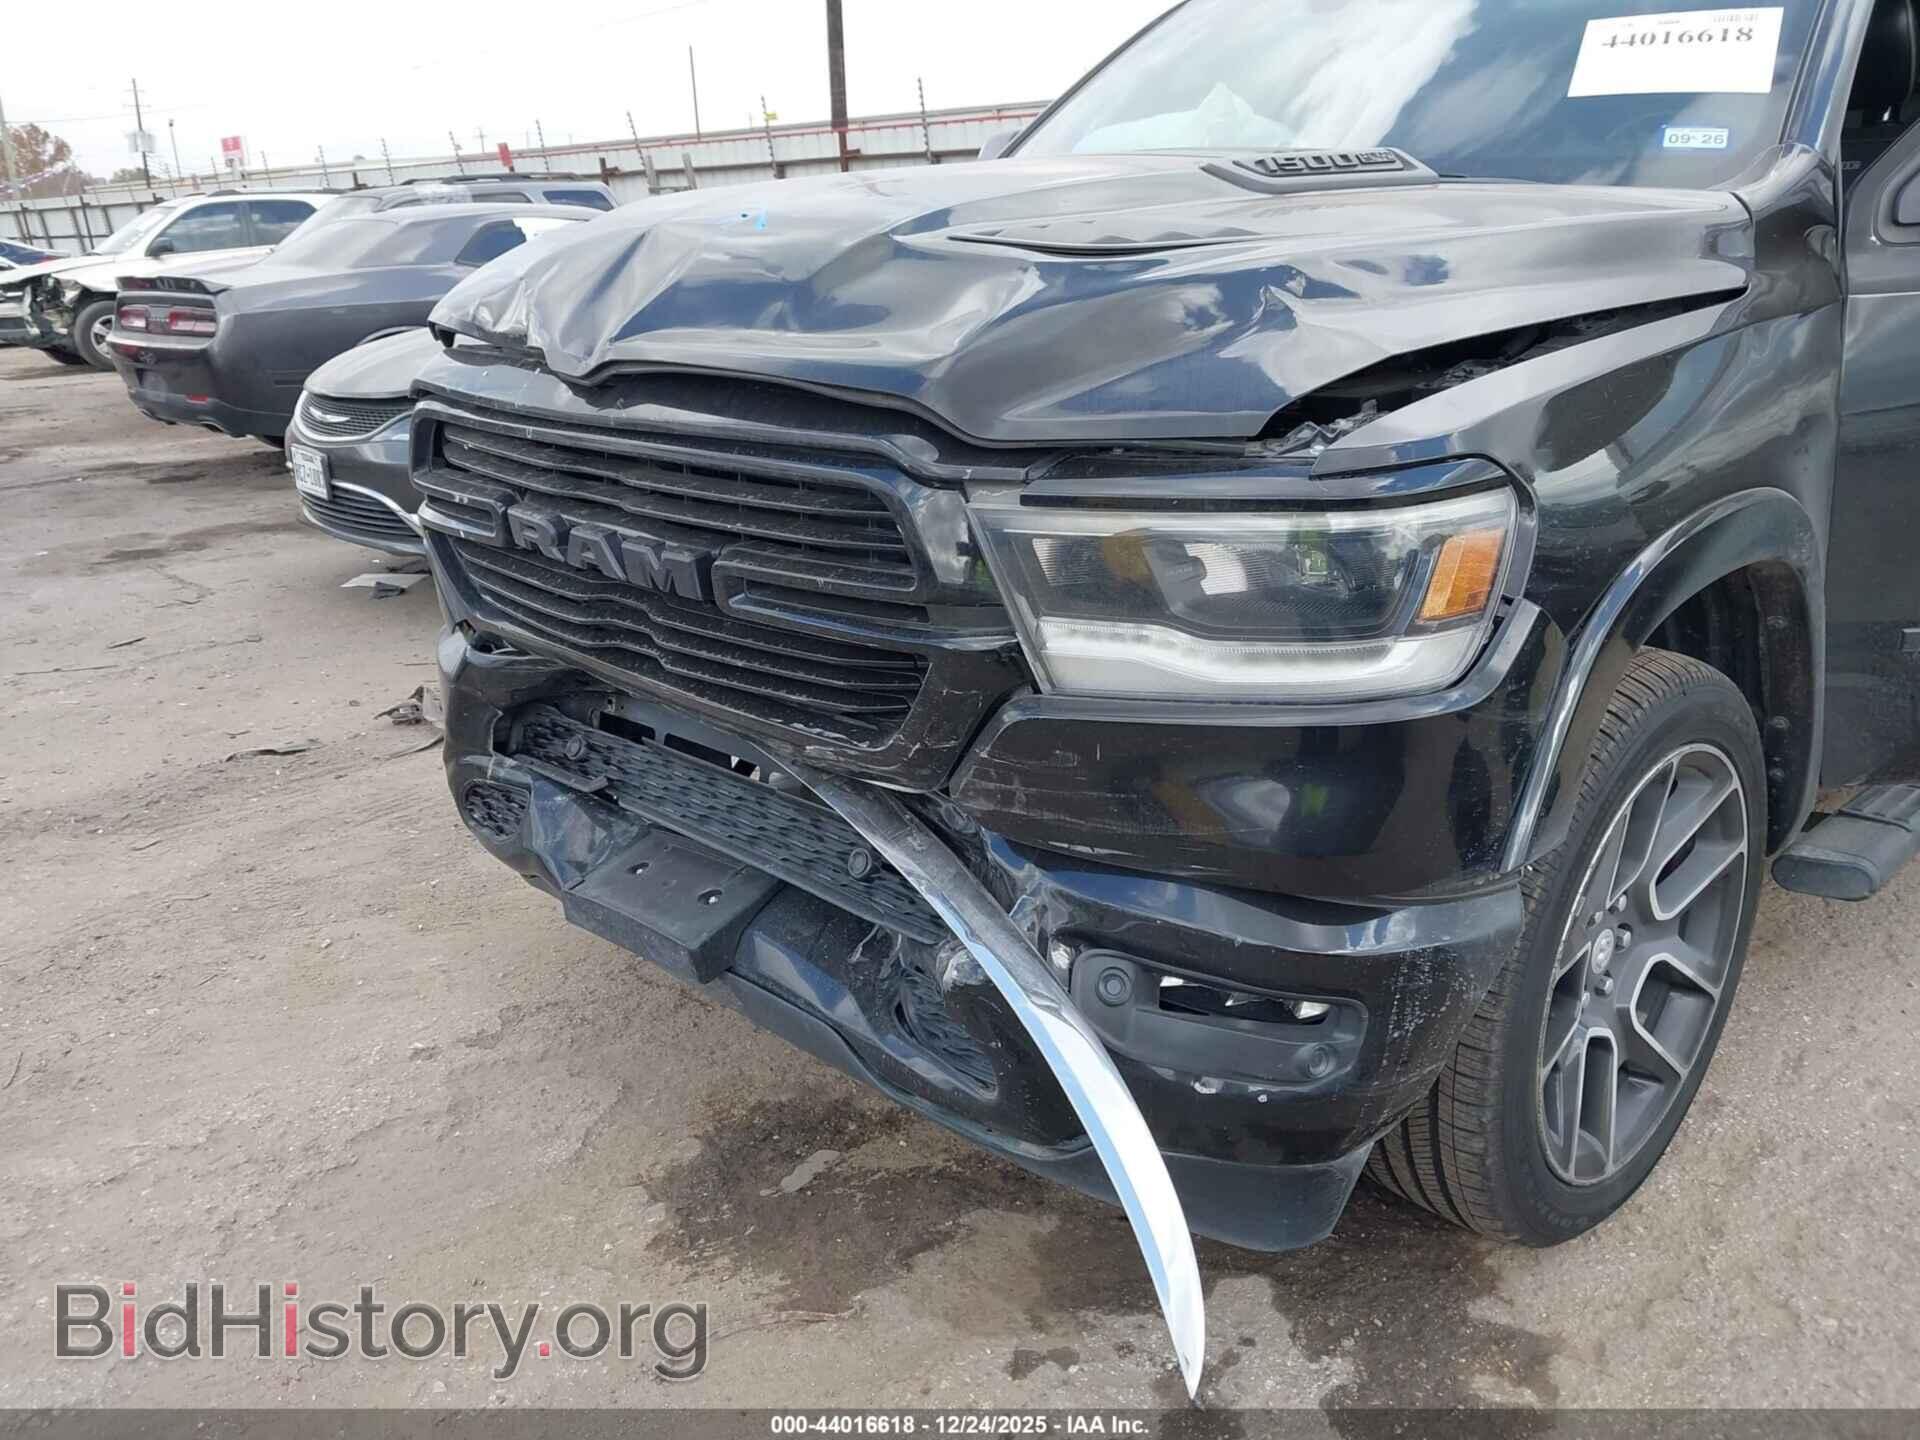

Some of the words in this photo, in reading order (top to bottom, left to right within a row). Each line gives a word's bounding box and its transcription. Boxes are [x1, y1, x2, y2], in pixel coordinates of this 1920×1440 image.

[1602, 27, 1754, 48] 44016618
[1668, 133, 1690, 144] 09
[1701, 133, 1725, 144] 26
[1260, 152, 1359, 172] 1500
[506, 505, 704, 601] RAM
